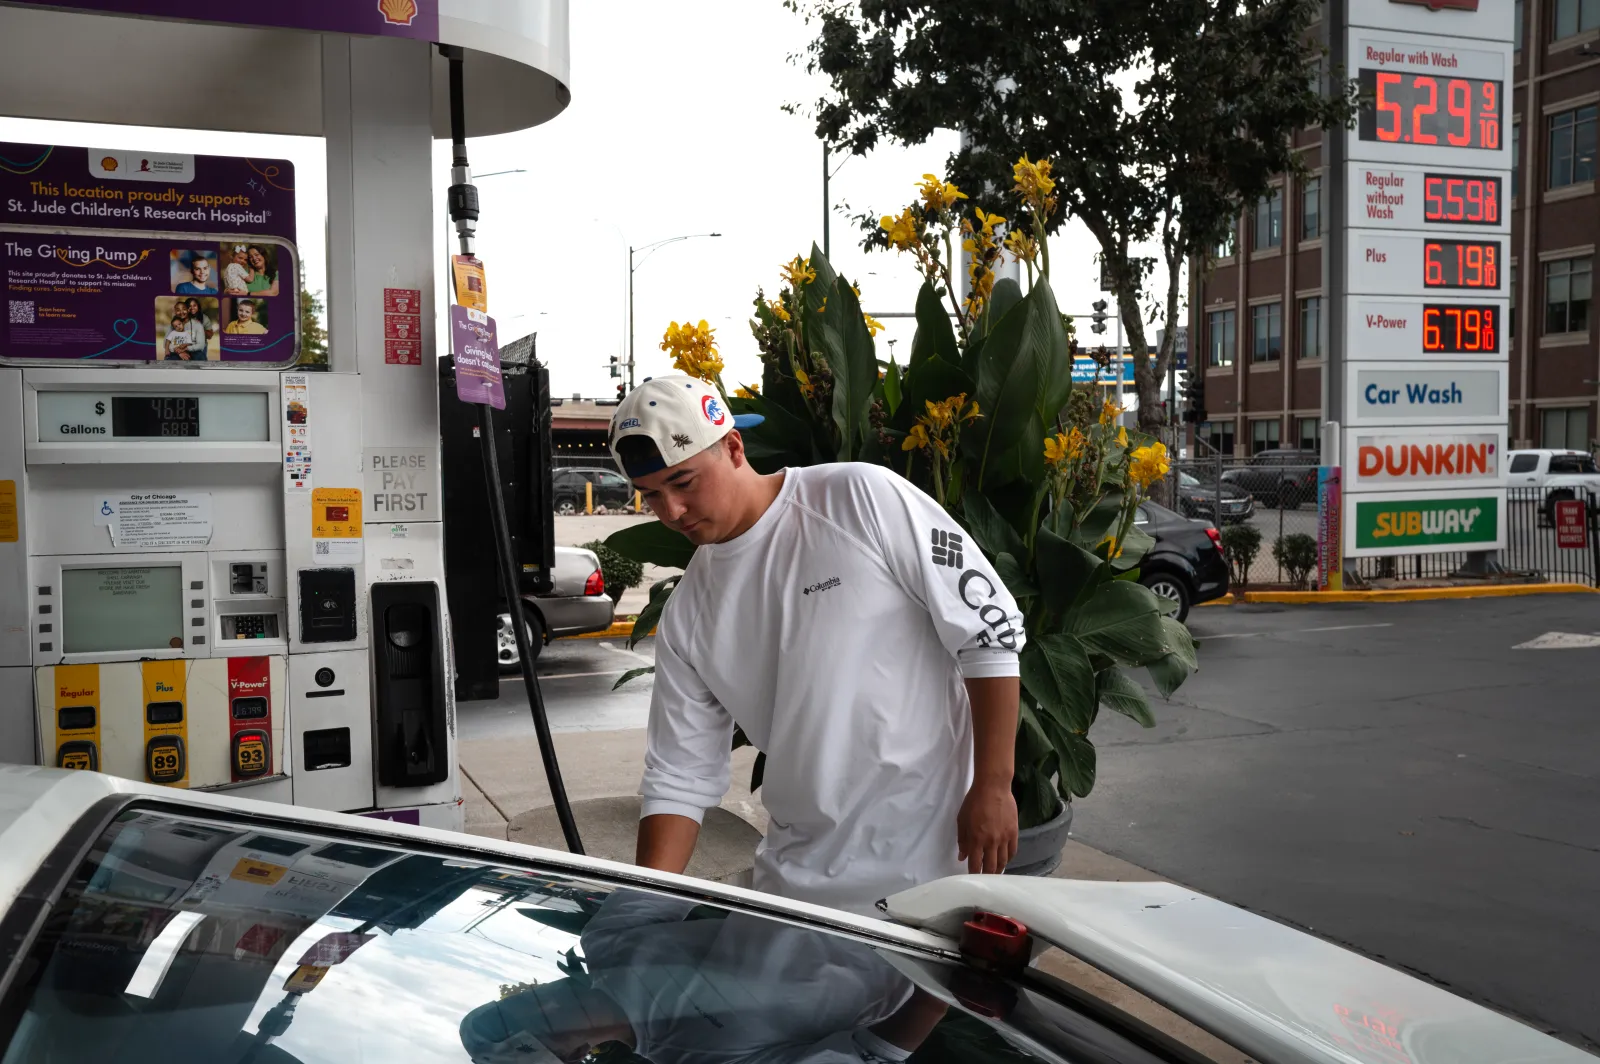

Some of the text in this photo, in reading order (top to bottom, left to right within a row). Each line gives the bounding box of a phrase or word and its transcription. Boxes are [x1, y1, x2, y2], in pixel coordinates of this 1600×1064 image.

[1366, 46, 1457, 68] Regular with Wash
[1376, 72, 1471, 146] 5.29
[1366, 171, 1404, 190] Regular
[30, 181, 250, 208] This location proudly supports
[1366, 191, 1404, 205] without
[1425, 177, 1483, 221] 5.59
[8, 199, 26, 212] St.
[31, 200, 66, 214] Jude
[71, 202, 140, 218] Children's
[144, 206, 206, 220] Research
[1366, 205, 1394, 219] Wash
[5, 242, 32, 257] The
[95, 247, 137, 264] Pump
[1366, 248, 1387, 263] Plus
[1425, 243, 1483, 286] 6.19
[34, 271, 60, 279] proudly
[1366, 314, 1407, 329] V-Power
[1423, 309, 1481, 350] 6.79
[464, 345, 485, 358] Giving
[457, 353, 480, 366] doesn't
[1365, 382, 1462, 405] Car Wash
[95, 401, 105, 416] $
[60, 424, 106, 434] Gallons
[373, 455, 426, 468] PLEASE
[1359, 443, 1495, 477] DUNKIN'
[383, 472, 418, 490] PAY
[374, 493, 428, 511] FIRST
[1562, 507, 1578, 515] THANK
[1372, 506, 1482, 539] SUBWAY
[1565, 516, 1576, 524] YOU
[1559, 525, 1583, 533] FOR YOUR
[1560, 535, 1583, 544] BUSINESS
[809, 577, 840, 593] Columbia
[231, 681, 266, 689] V-Power
[60, 689, 94, 698] Regular
[154, 754, 177, 769] 89
[240, 750, 264, 764] 93
